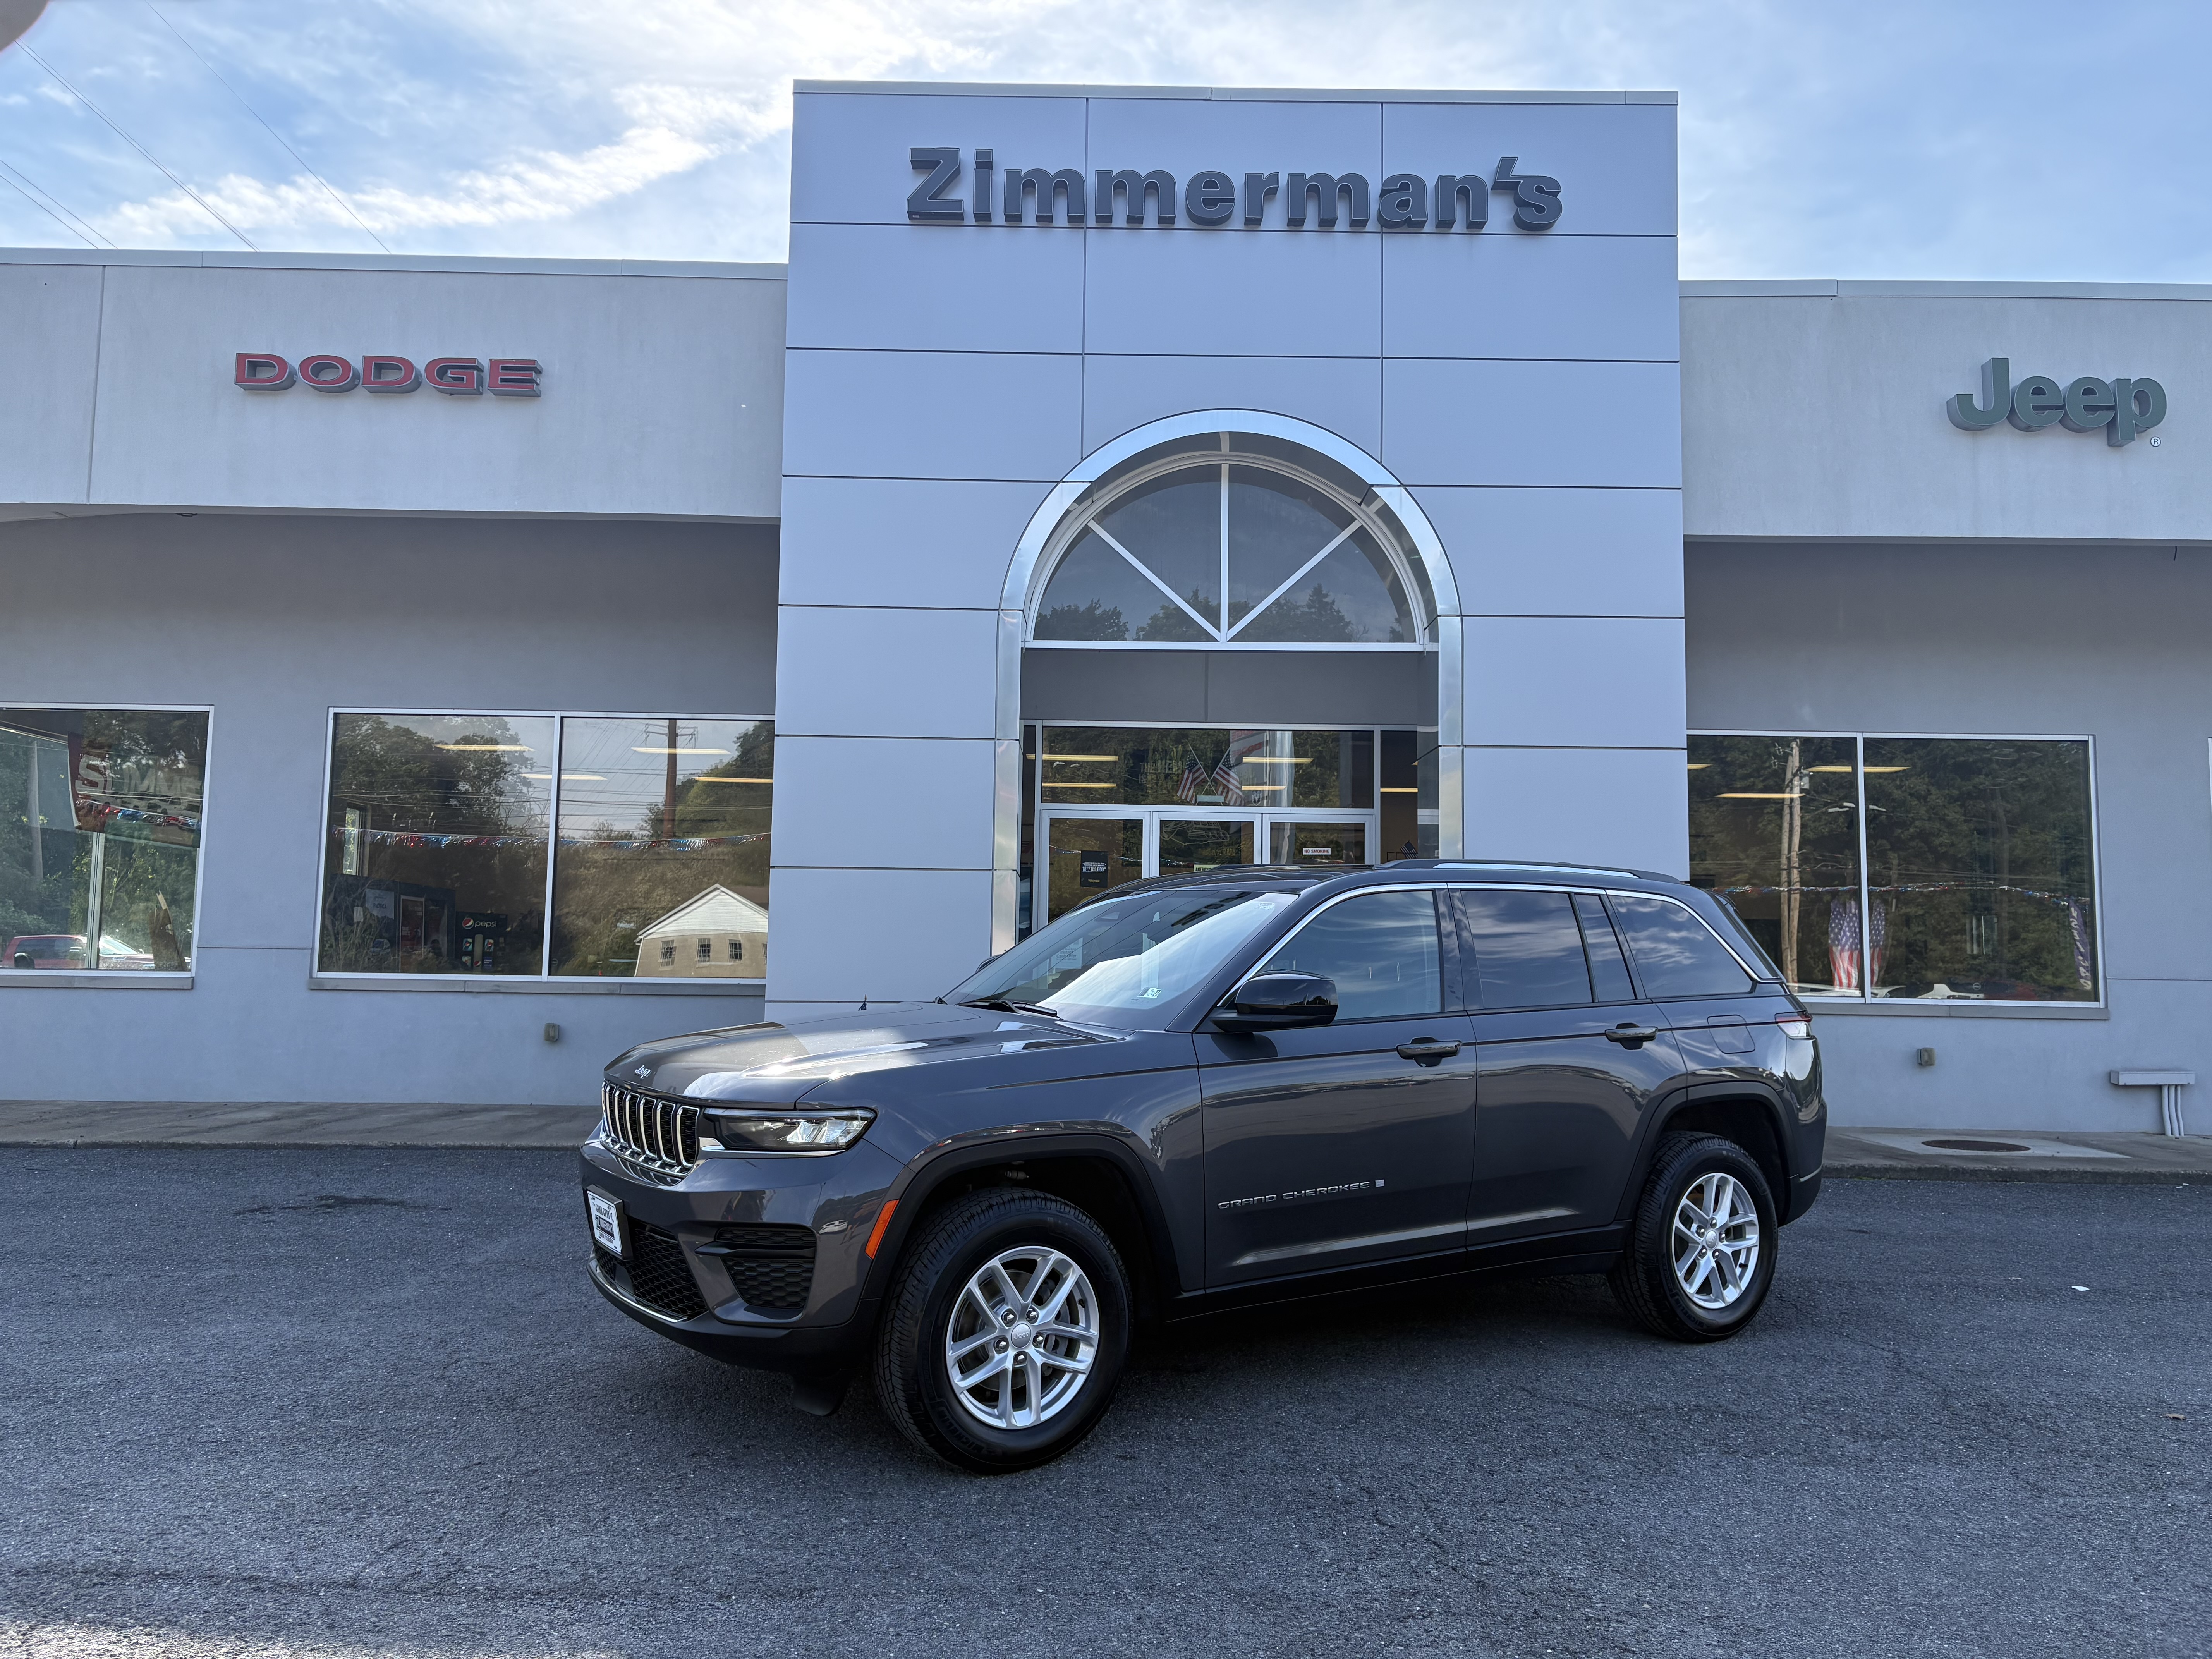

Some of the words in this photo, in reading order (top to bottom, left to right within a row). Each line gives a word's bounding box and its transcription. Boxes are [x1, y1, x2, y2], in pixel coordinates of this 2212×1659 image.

[906, 147, 1563, 232] Zimmerman's
[234, 353, 543, 396] DODGE
[1946, 357, 2167, 446] Jeep
[1218, 1194, 1277, 1209] GRAND
[1282, 1182, 1370, 1200] CHEROKEE
